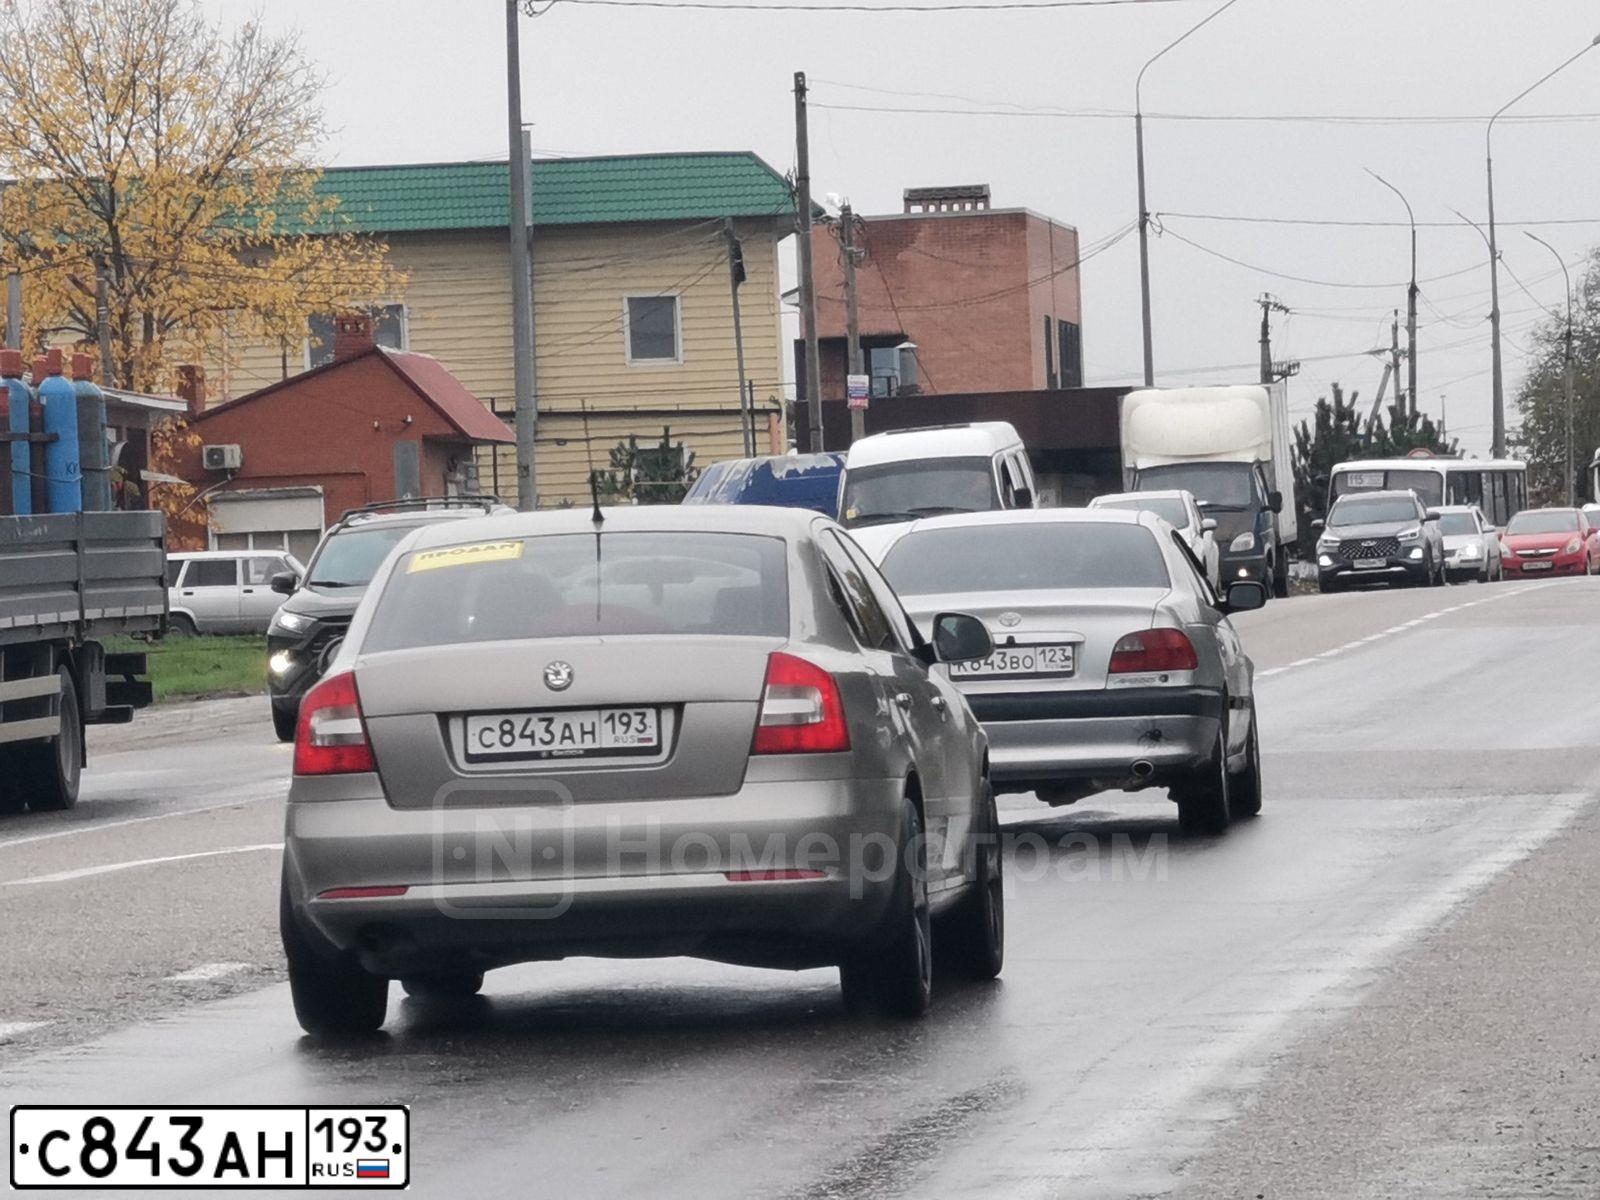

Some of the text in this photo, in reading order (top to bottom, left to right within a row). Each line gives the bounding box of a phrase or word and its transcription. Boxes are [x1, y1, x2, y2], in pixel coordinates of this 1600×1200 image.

[1039, 647, 1068, 663] 123
[478, 711, 648, 748] С843АН 193
[613, 735, 636, 744] RUS
